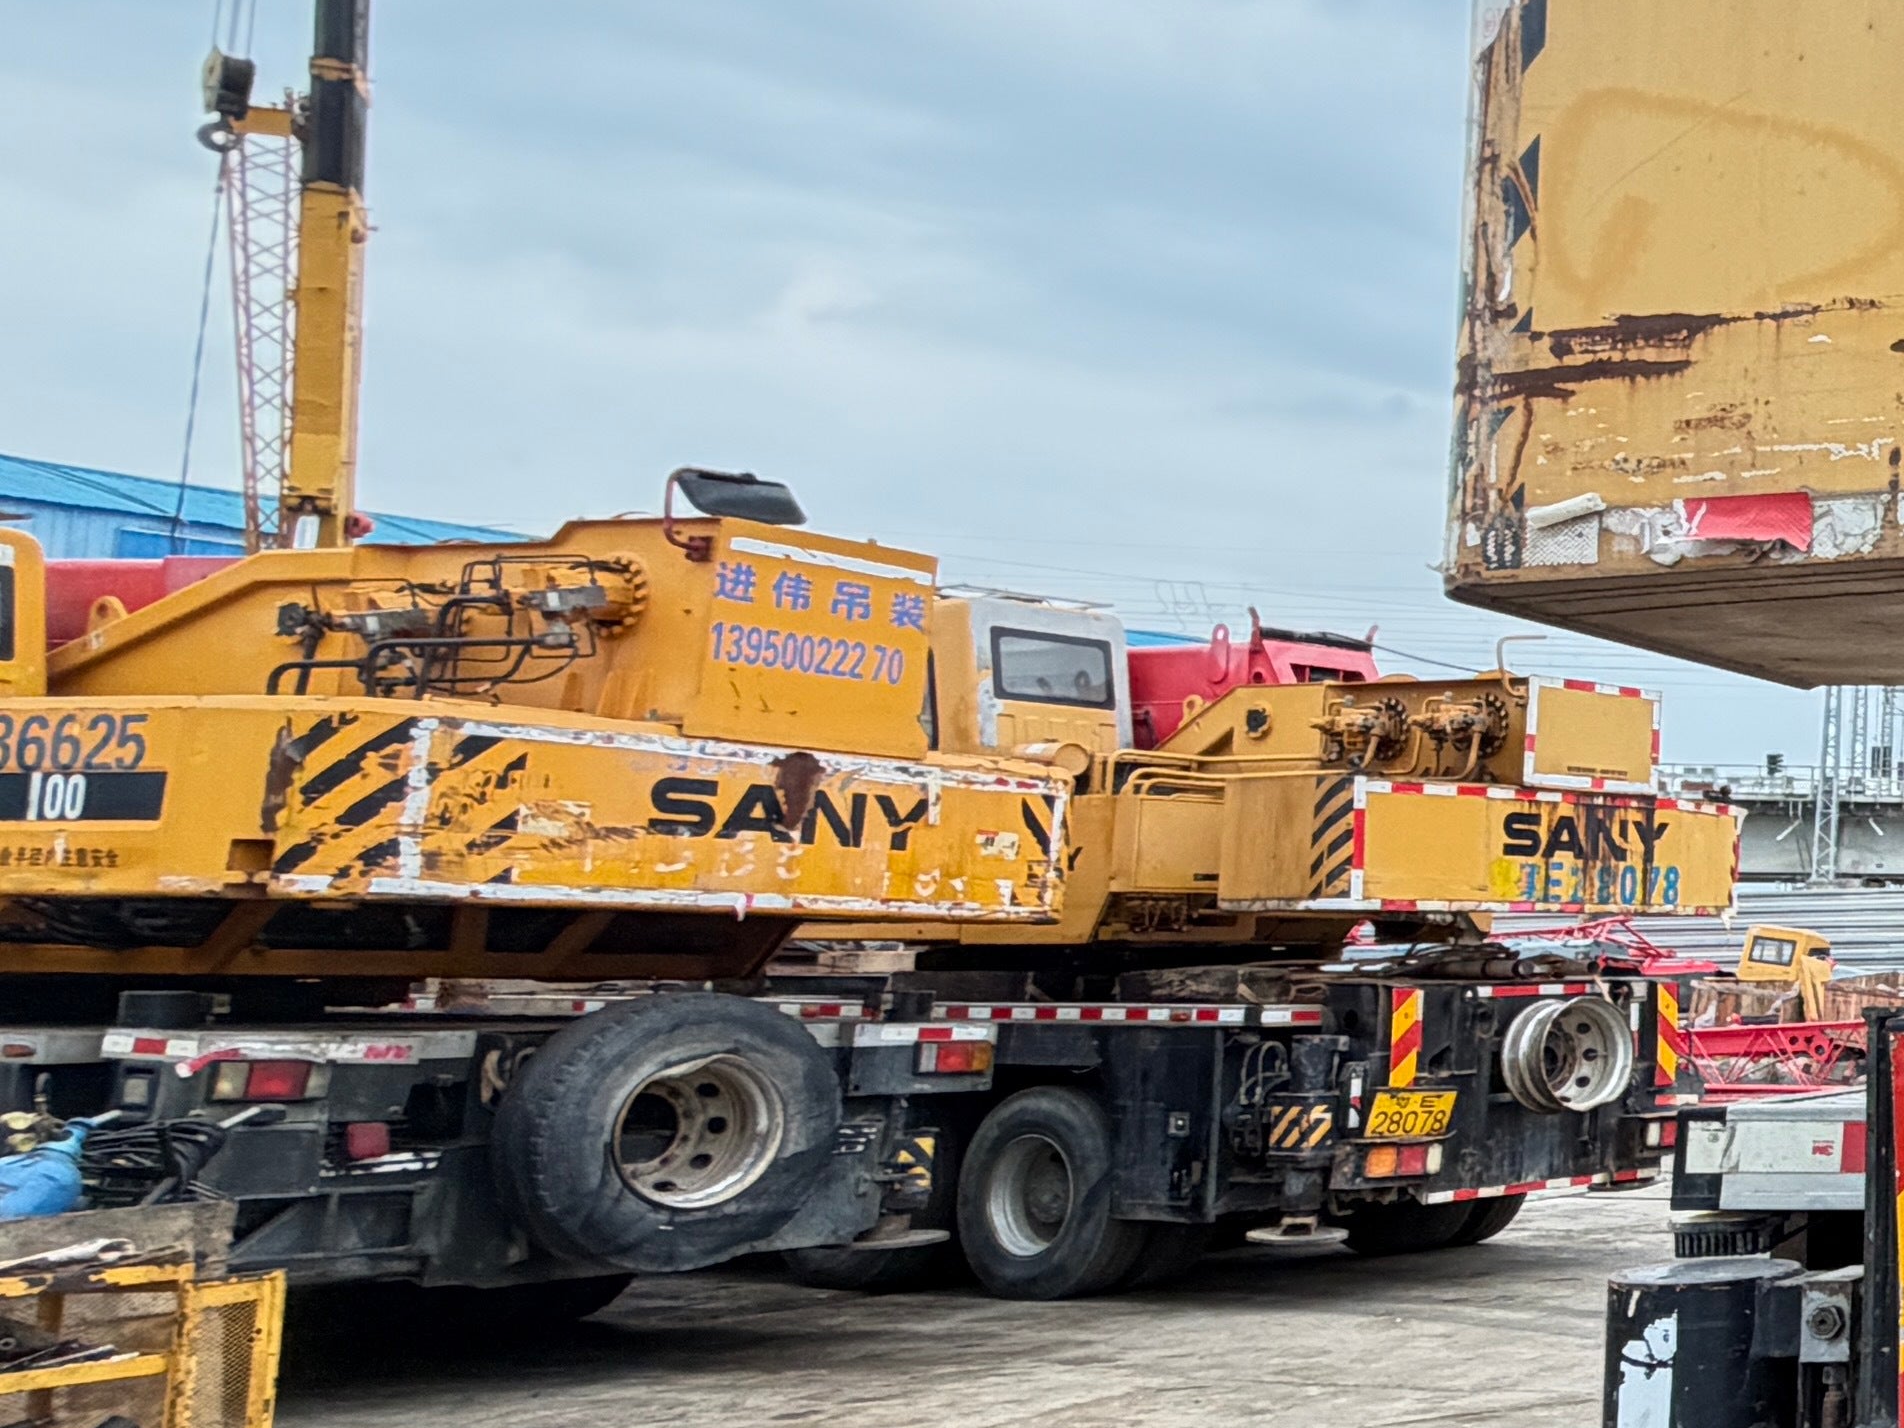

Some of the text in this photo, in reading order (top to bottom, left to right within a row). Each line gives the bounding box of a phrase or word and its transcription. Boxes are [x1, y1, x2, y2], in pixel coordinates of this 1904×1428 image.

[714, 562, 926, 632] 进伟吊装
[26, 772, 87, 821] 100
[648, 776, 929, 851] SANY
[1503, 813, 1669, 863] SANY
[1371, 1110, 1447, 1135] 28078
